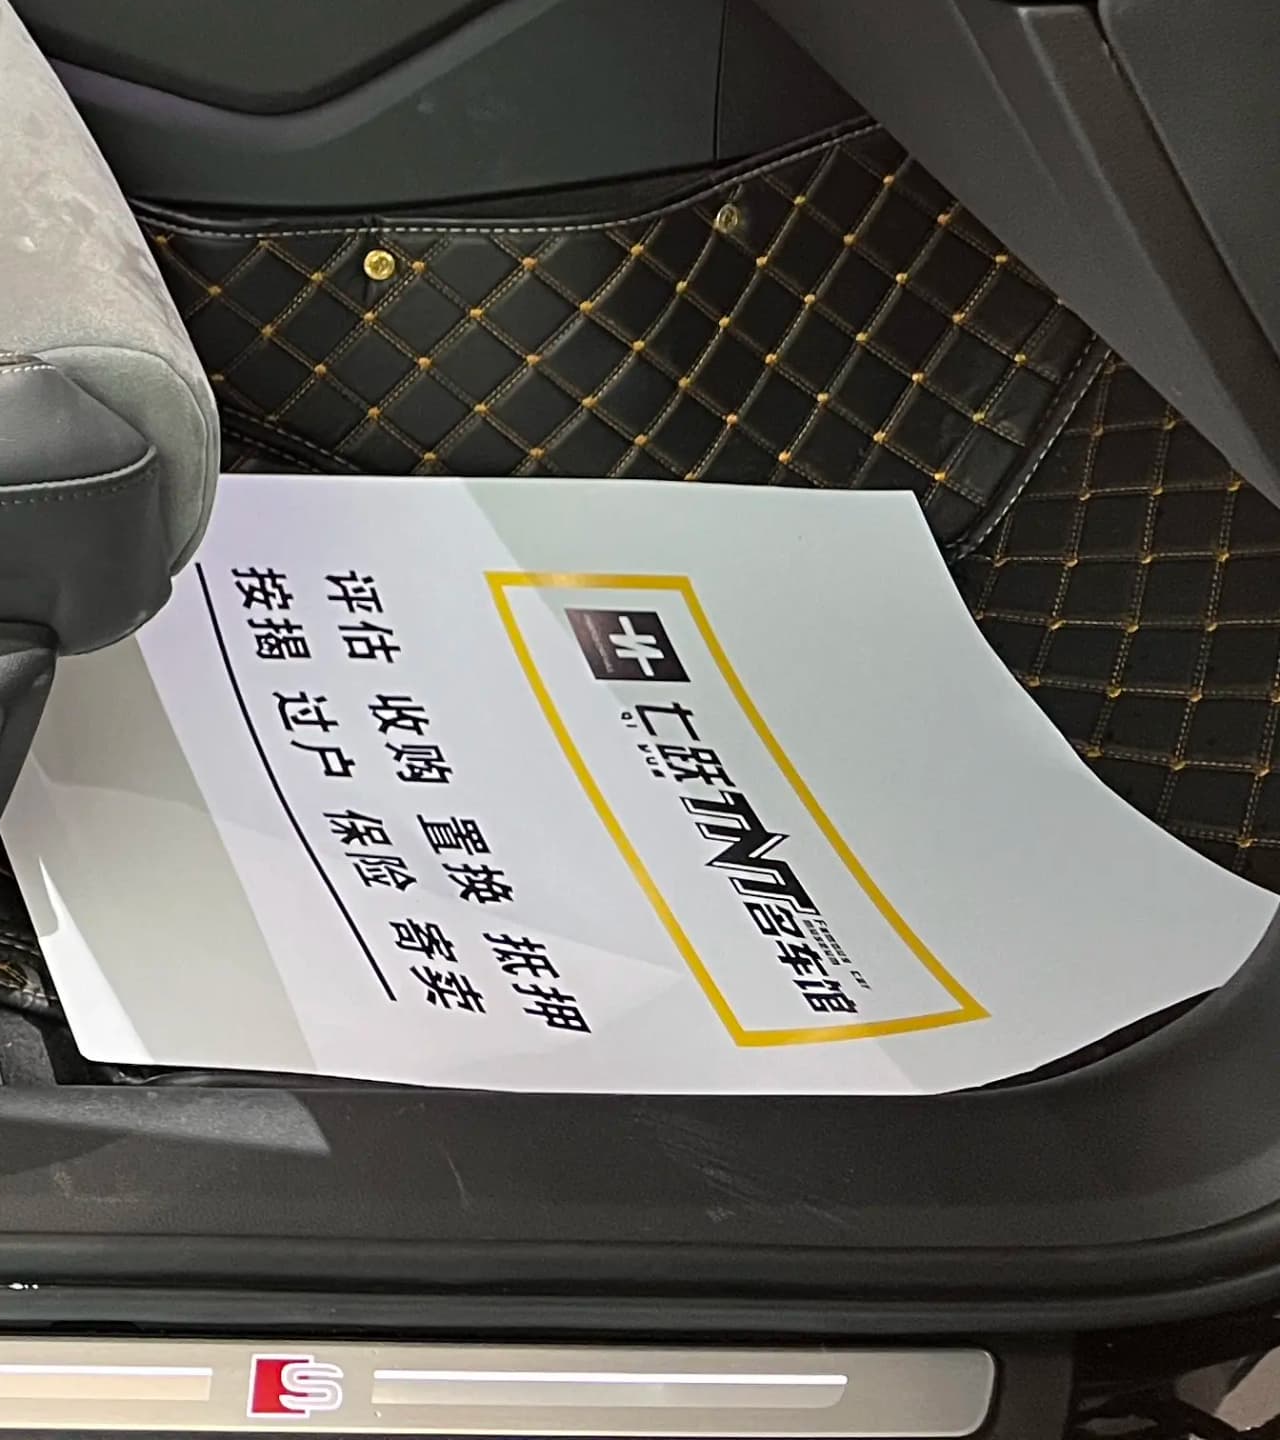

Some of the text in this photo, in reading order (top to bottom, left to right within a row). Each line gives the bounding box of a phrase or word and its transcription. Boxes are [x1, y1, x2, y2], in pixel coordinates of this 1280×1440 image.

[231, 567, 487, 1014] 按揭 过户 保险 寄卖
[325, 569, 592, 1034] 评估 收购 置换 抵押
[277, 1359, 345, 1413] S
